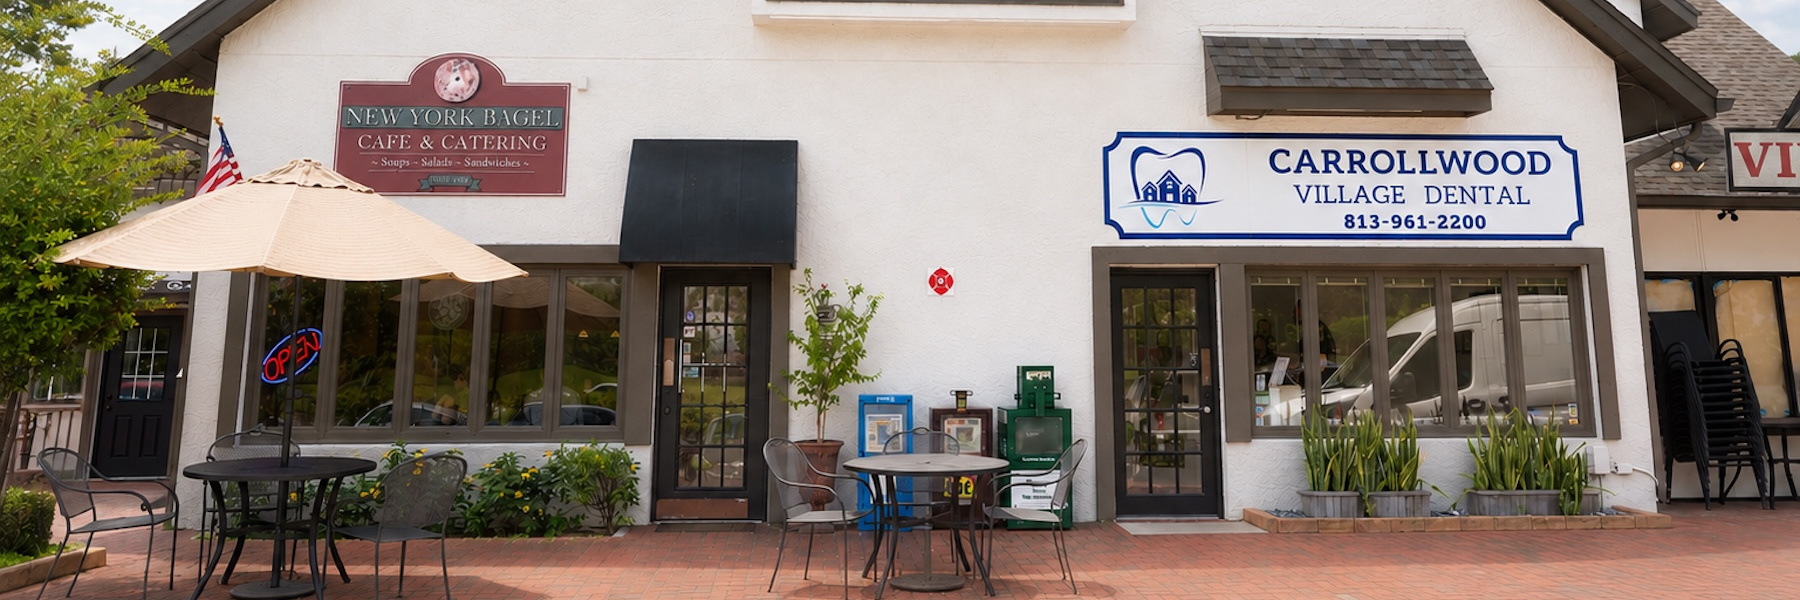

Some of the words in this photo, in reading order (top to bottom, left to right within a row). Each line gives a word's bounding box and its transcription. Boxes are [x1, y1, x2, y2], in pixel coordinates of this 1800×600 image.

[346, 107, 402, 126] NEW
[410, 108, 475, 126] YORK
[483, 108, 560, 127] BAGEL
[357, 134, 412, 149] CAFE
[419, 135, 434, 149] &
[441, 134, 547, 151] CATERING
[380, 157, 411, 168] Soups
[421, 157, 452, 168] Salads
[464, 157, 521, 168] Sandwiches
[1268, 148, 1552, 176] CARROLLWOOD
[1733, 141, 1800, 178] VI
[1293, 184, 1406, 204] VILLAGE
[1424, 185, 1531, 206] DENTAL
[1343, 213, 1487, 231] 813-961-2200
[264, 332, 319, 381] OPEN
